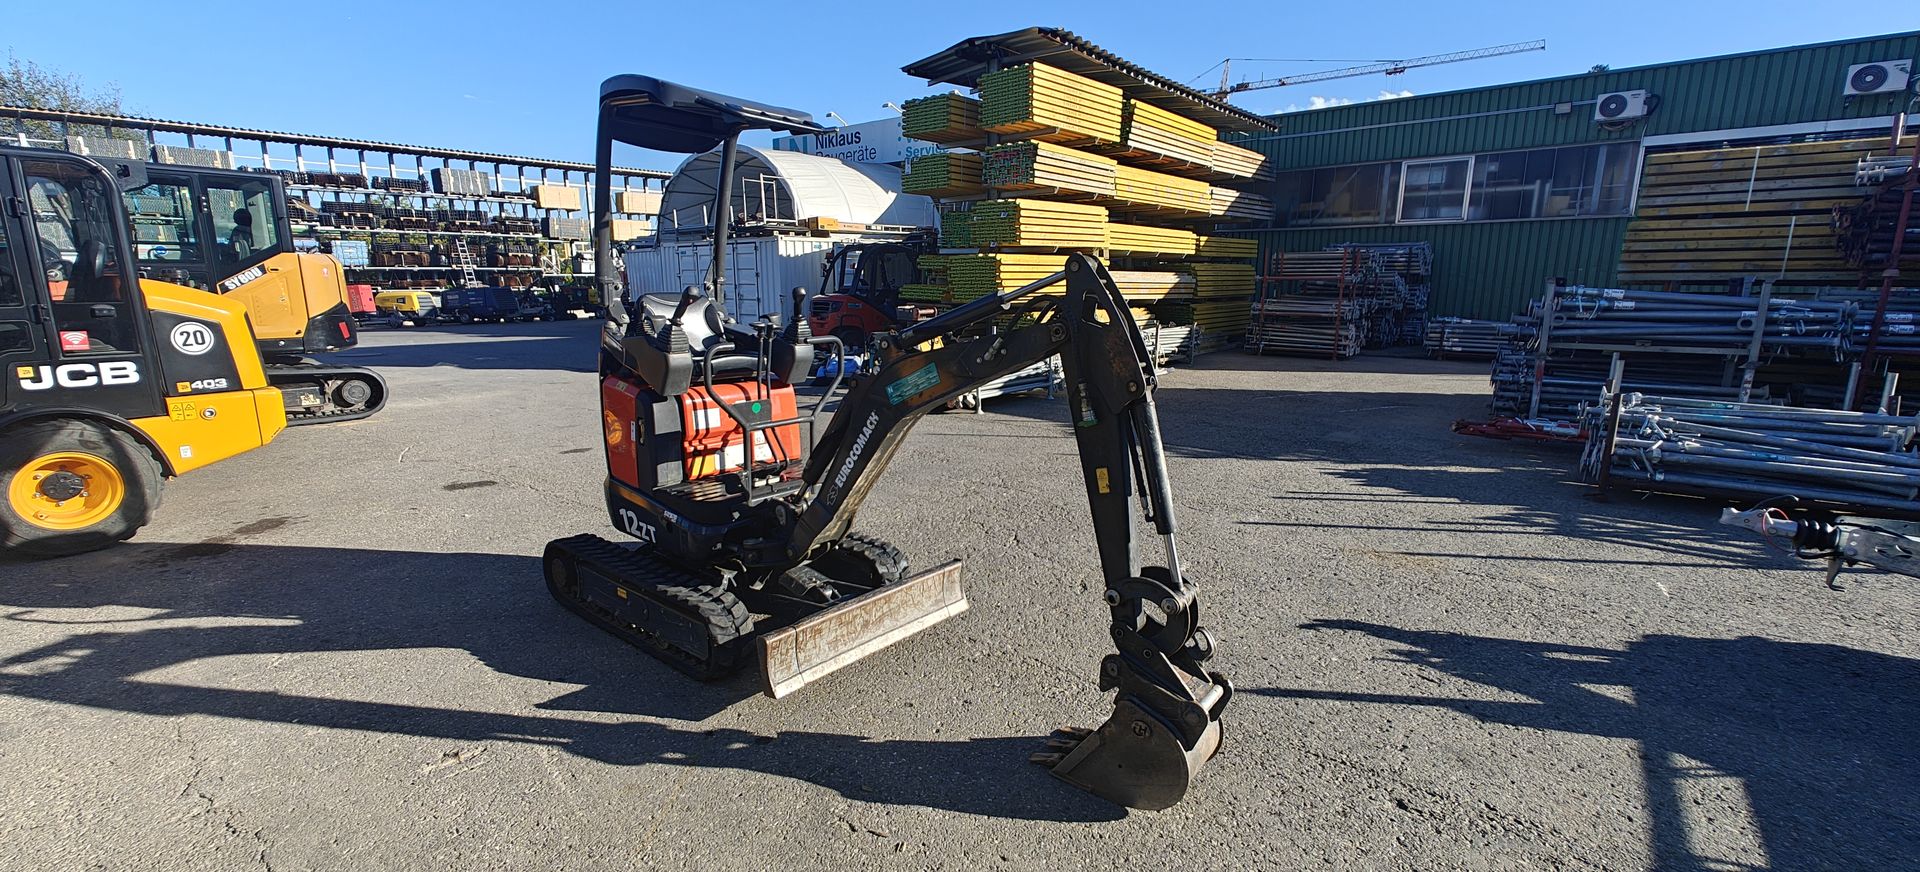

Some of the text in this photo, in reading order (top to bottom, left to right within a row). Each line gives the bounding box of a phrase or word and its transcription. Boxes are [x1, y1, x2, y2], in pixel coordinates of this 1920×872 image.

[815, 131, 862, 150] Niklaus
[224, 266, 263, 290] SY80U
[180, 330, 206, 347] 20
[20, 361, 140, 390] JCB
[191, 378, 228, 391] 403
[835, 411, 879, 488] EUROCOMACH
